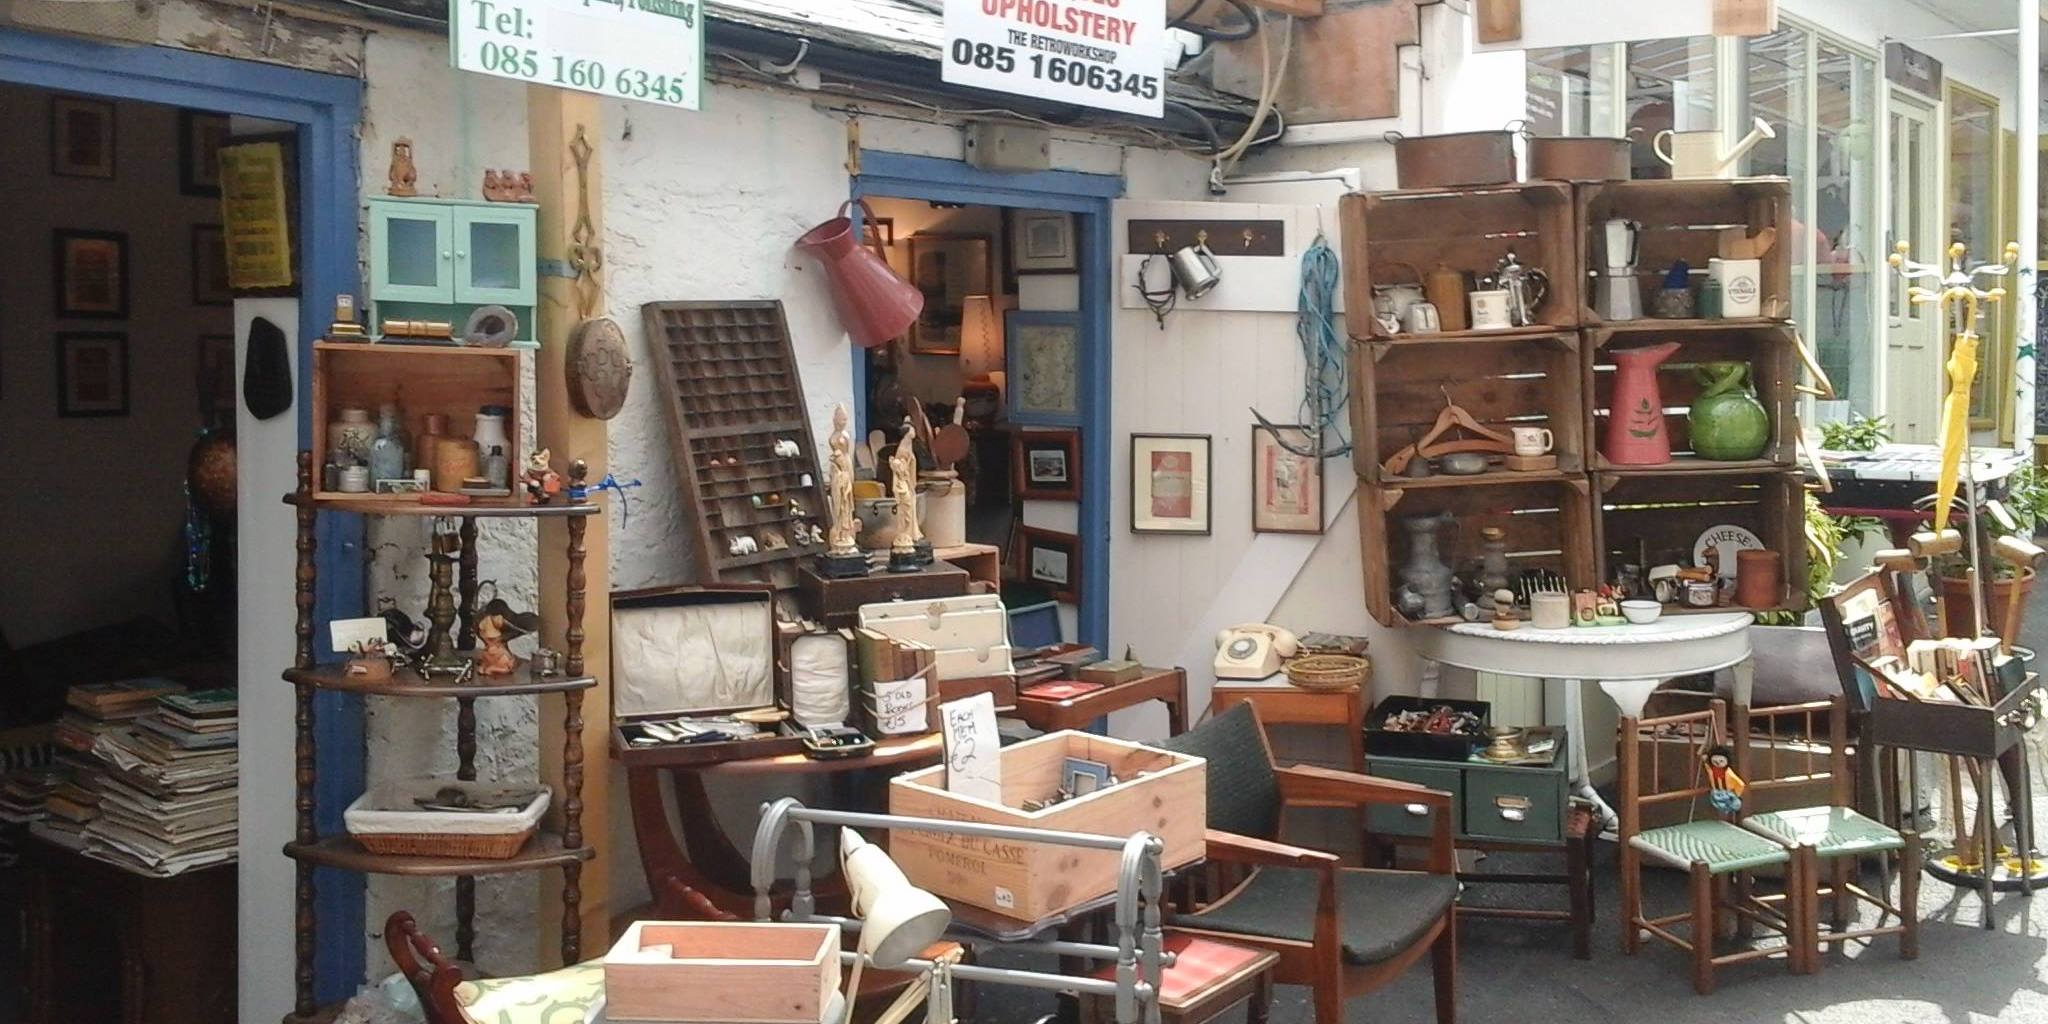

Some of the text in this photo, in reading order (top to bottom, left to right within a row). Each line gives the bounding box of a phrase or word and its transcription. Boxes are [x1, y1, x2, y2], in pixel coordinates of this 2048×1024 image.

[471, 0, 534, 39] Tel:
[981, 0, 1137, 45] UPHOLSTERY
[1008, 28, 1118, 65] THE RETROWORKSHOP
[480, 41, 684, 104] 085 160 6345
[952, 38, 1158, 100] 085 1606345
[1705, 530, 1752, 548] CHEESE
[949, 709, 974, 728] EACH
